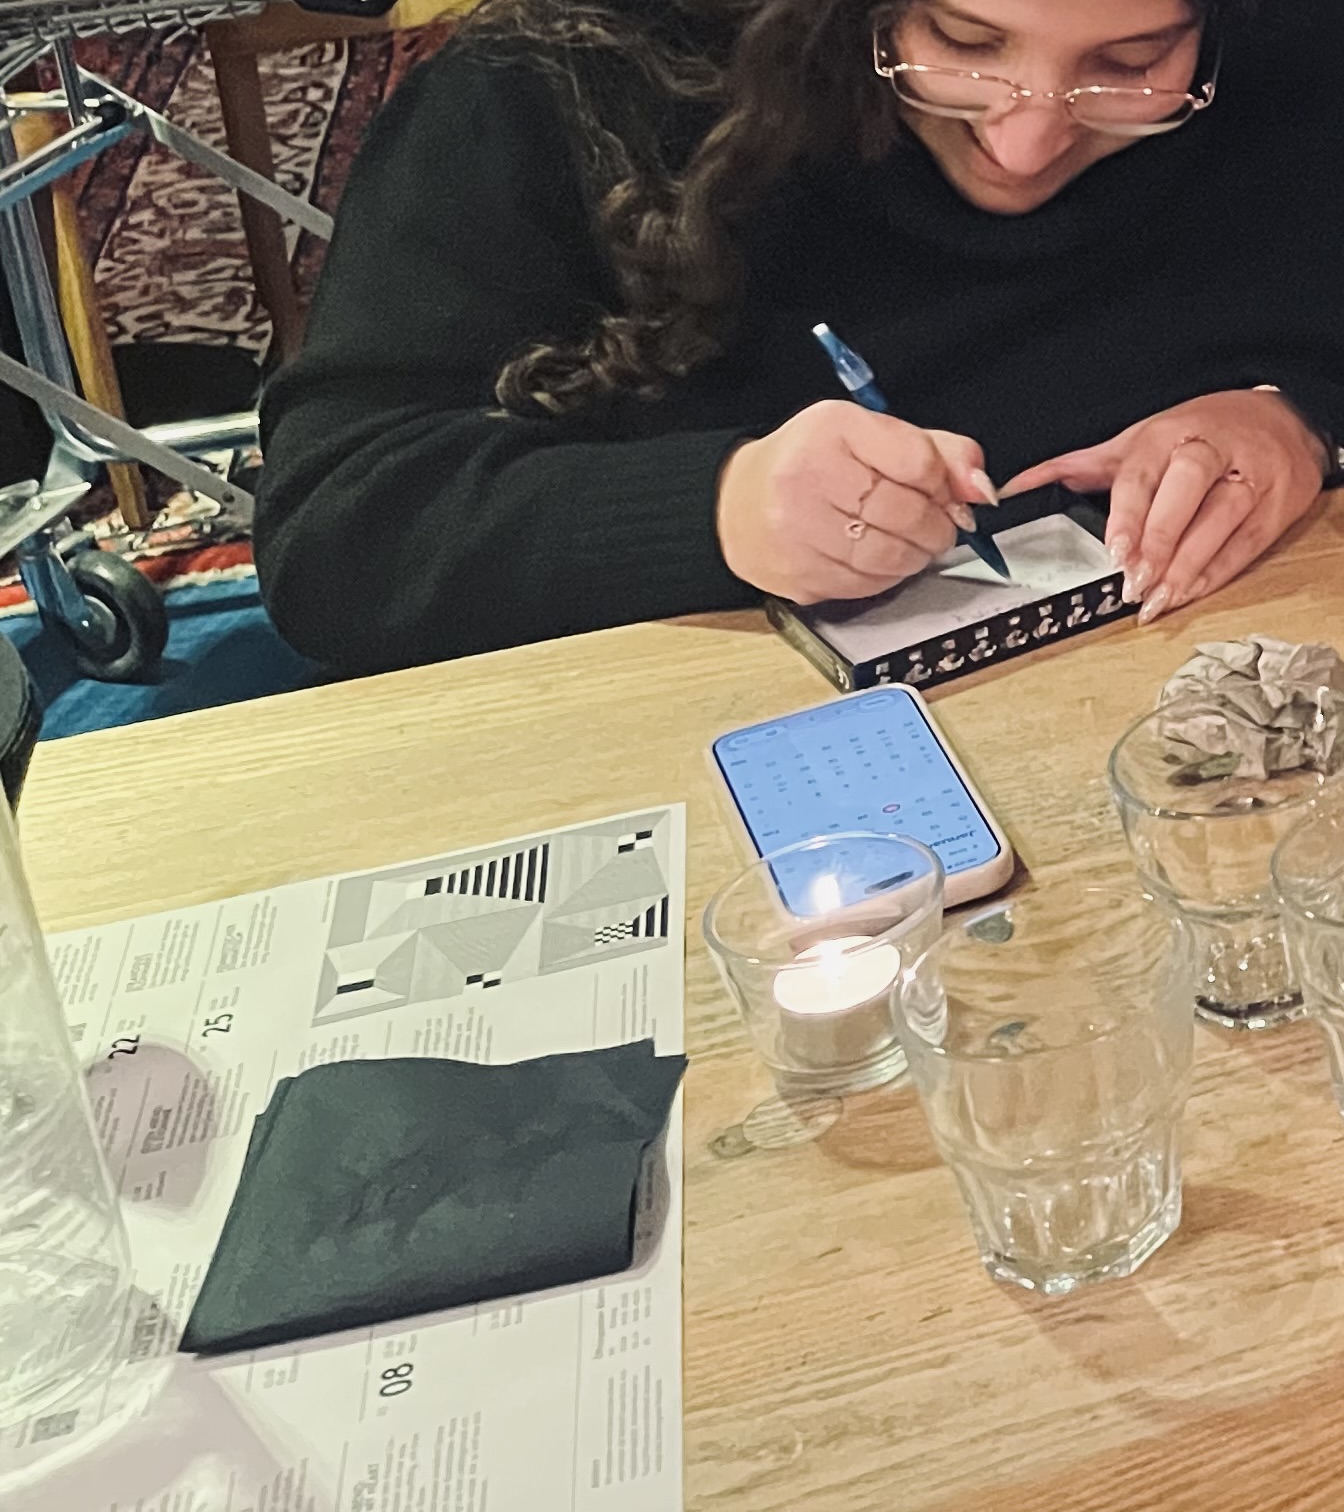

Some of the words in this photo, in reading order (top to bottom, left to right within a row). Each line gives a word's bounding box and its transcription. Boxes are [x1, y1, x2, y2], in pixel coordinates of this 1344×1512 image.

[201, 1013, 234, 1037] 25
[108, 1034, 141, 1059] 22
[379, 1363, 414, 1397] 08
